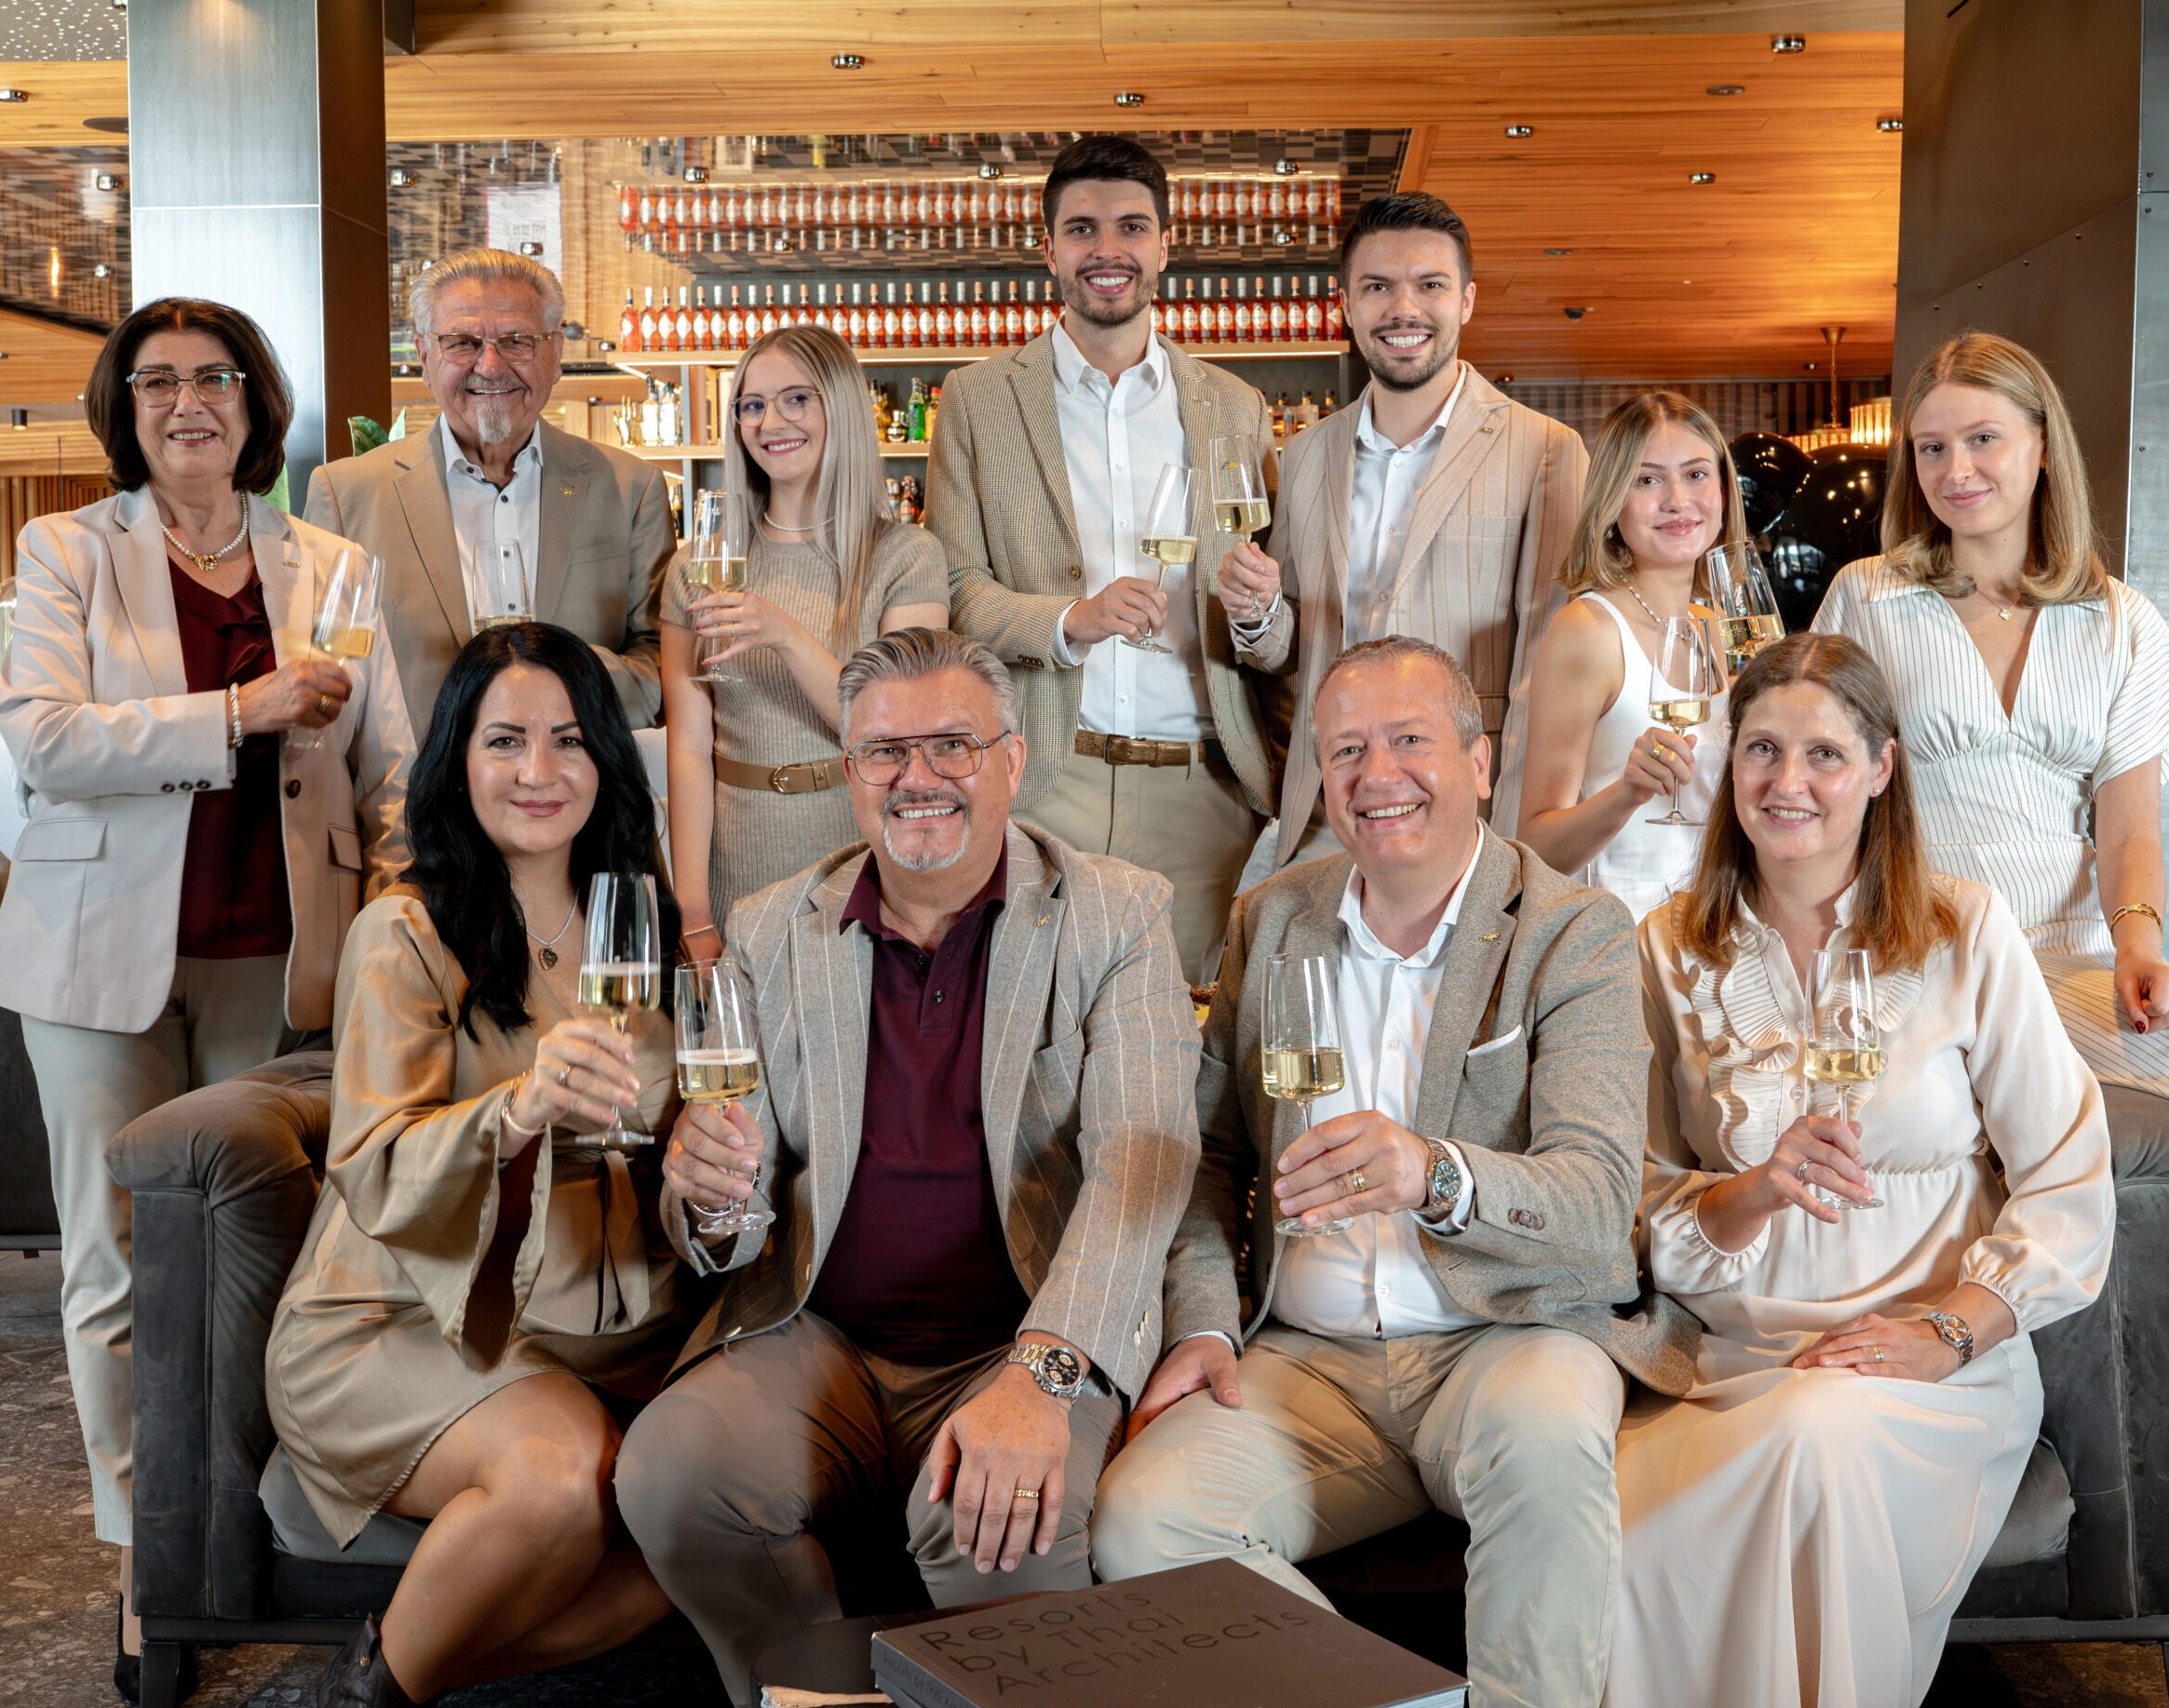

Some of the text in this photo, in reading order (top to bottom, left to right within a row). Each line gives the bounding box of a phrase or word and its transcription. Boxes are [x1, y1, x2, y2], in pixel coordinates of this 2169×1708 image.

[918, 1592, 1152, 1651] Resorts
[947, 1607, 1185, 1674] by Thai
[995, 1608, 1310, 1697] Architects
